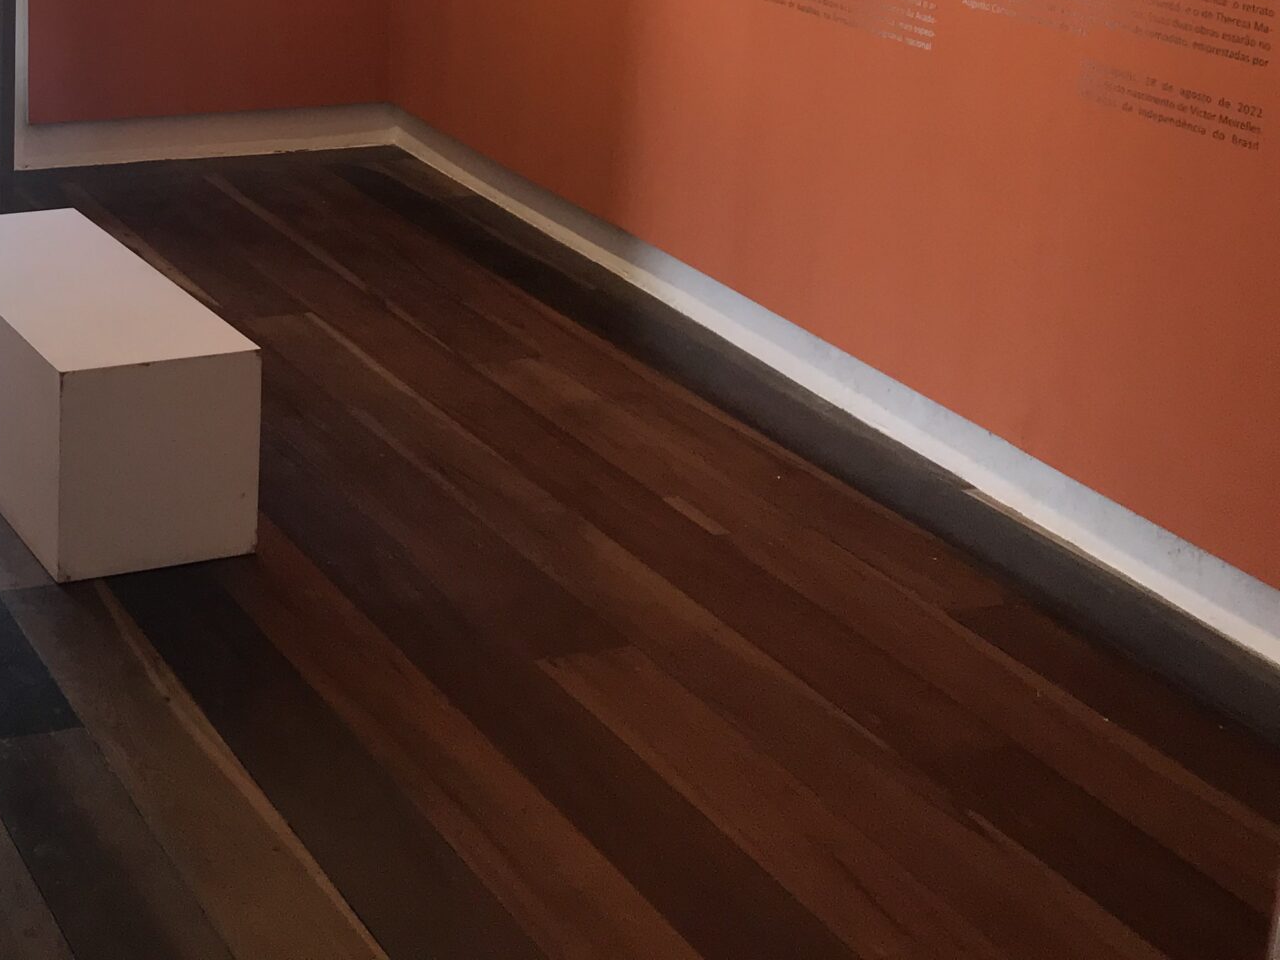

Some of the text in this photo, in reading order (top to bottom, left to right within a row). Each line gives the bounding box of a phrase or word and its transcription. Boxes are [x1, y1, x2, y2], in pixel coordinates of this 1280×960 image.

[1252, 55, 1270, 67] por
[1189, 104, 1216, 121] Victor
[1218, 96, 1231, 109] de
[1237, 102, 1263, 119] 2022
[1212, 129, 1226, 141] do
[1231, 134, 1260, 151] Brasil
